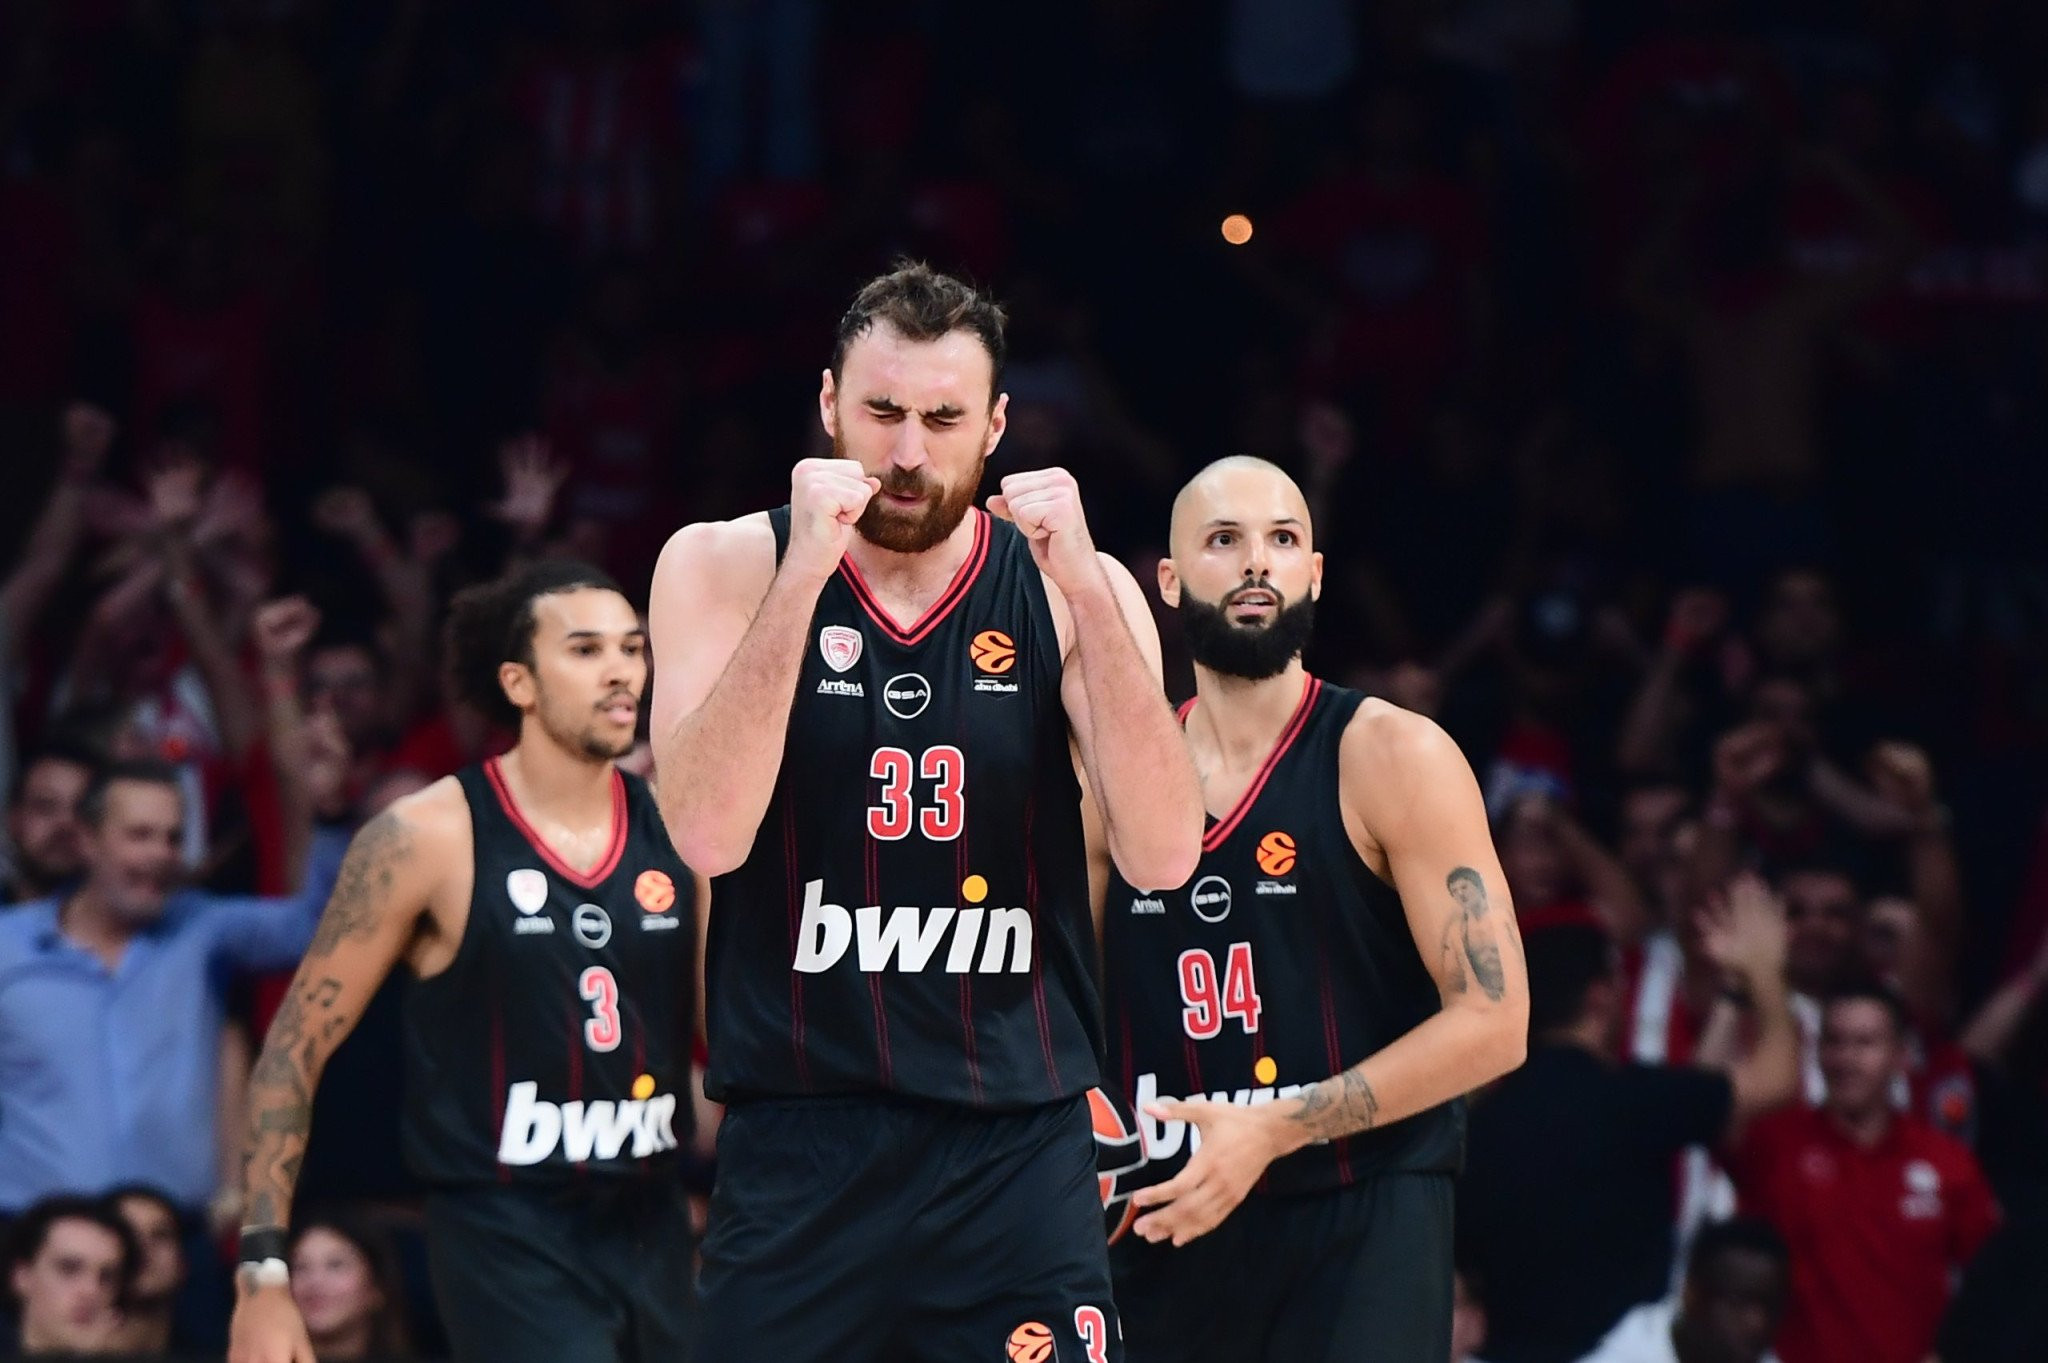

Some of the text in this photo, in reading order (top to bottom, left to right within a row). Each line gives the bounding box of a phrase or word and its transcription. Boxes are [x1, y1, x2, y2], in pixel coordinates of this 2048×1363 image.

[867, 745, 965, 841] 33
[793, 874, 1033, 973] bwin
[579, 965, 622, 1053] 3
[1177, 941, 1262, 1040] 94
[497, 1073, 678, 1165] bwin
